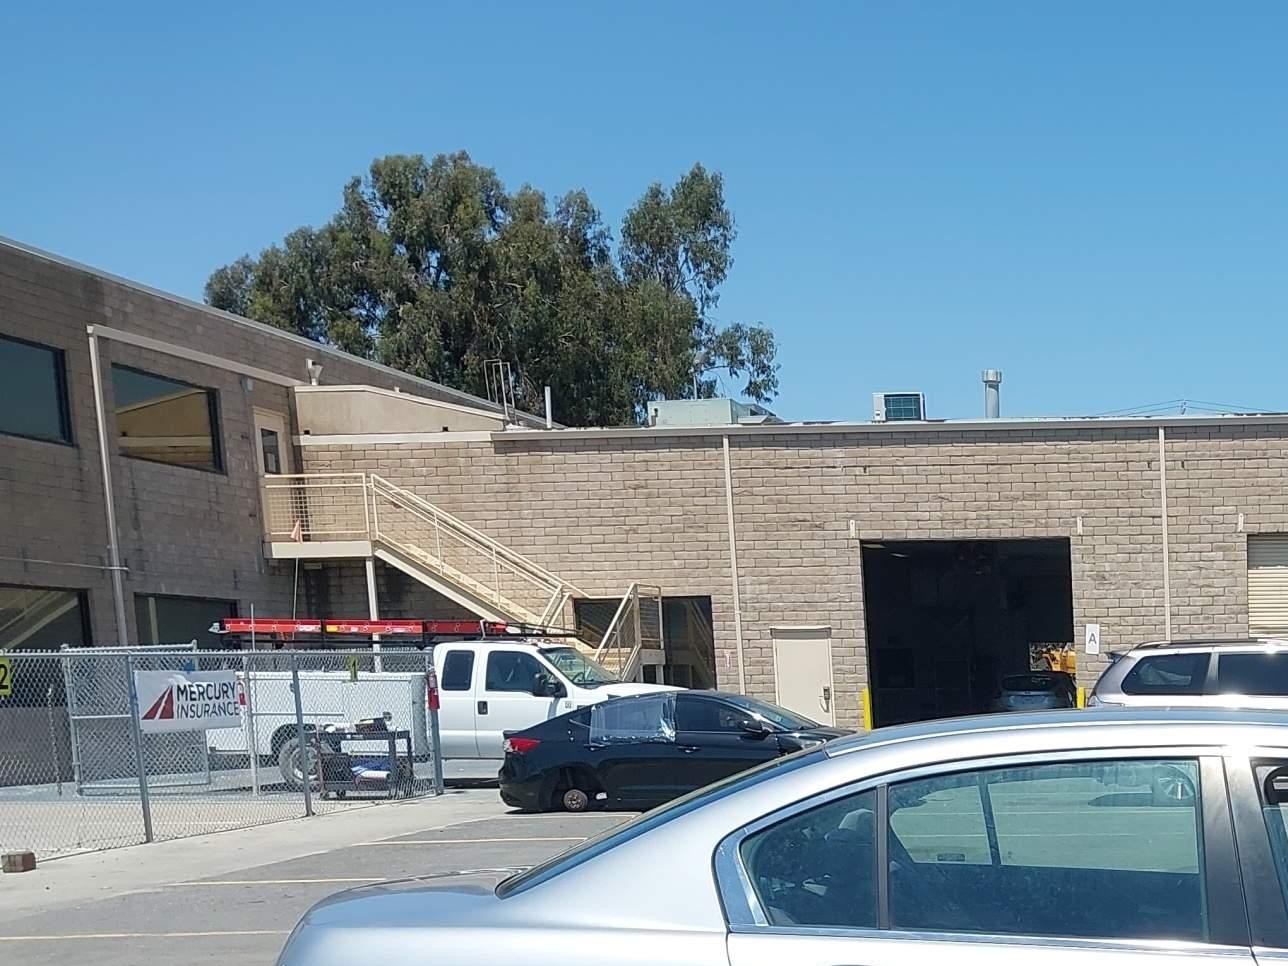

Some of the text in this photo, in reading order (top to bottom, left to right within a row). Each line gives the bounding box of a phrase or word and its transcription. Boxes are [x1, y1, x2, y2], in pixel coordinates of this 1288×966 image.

[1088, 632, 1097, 645] A
[176, 682, 236, 702] MERCURY
[176, 701, 240, 719] INSURANCE
